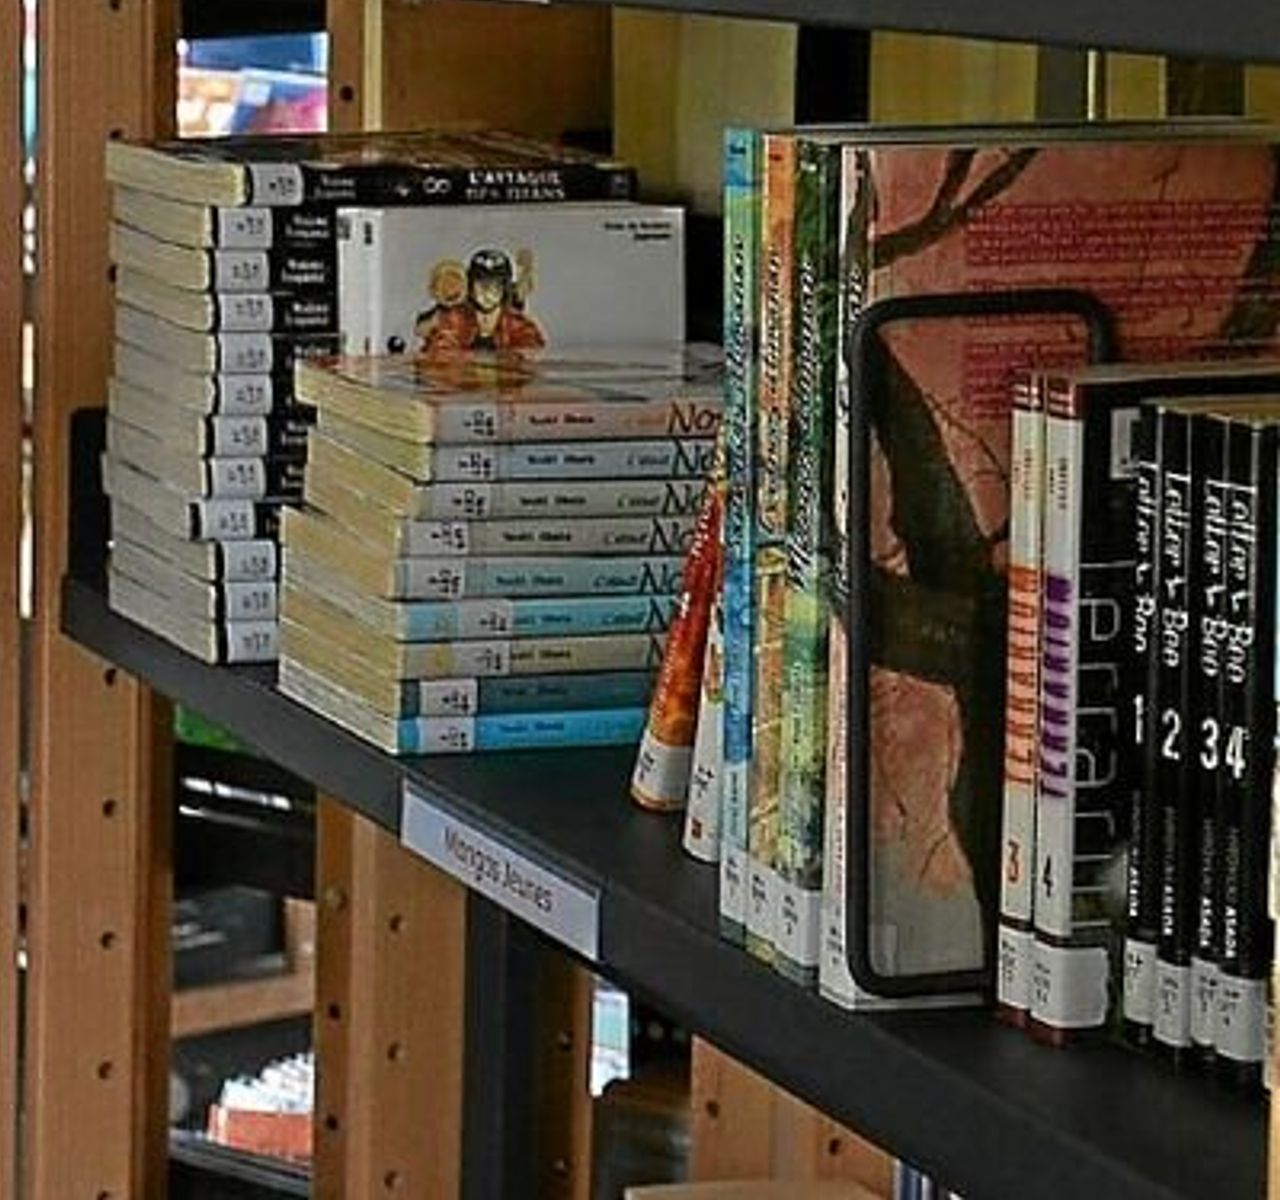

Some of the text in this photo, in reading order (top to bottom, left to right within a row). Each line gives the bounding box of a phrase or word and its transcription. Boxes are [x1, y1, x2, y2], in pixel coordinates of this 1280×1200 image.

[667, 402, 722, 435] No
[673, 438, 717, 477] No
[1133, 694, 1144, 744] 1
[1162, 708, 1182, 760] 2
[1200, 717, 1219, 770] 3
[1225, 727, 1246, 779] 4
[444, 827, 553, 913] Mangas Jeunes
[1006, 840, 1021, 884] 3
[1041, 855, 1054, 899] 4
